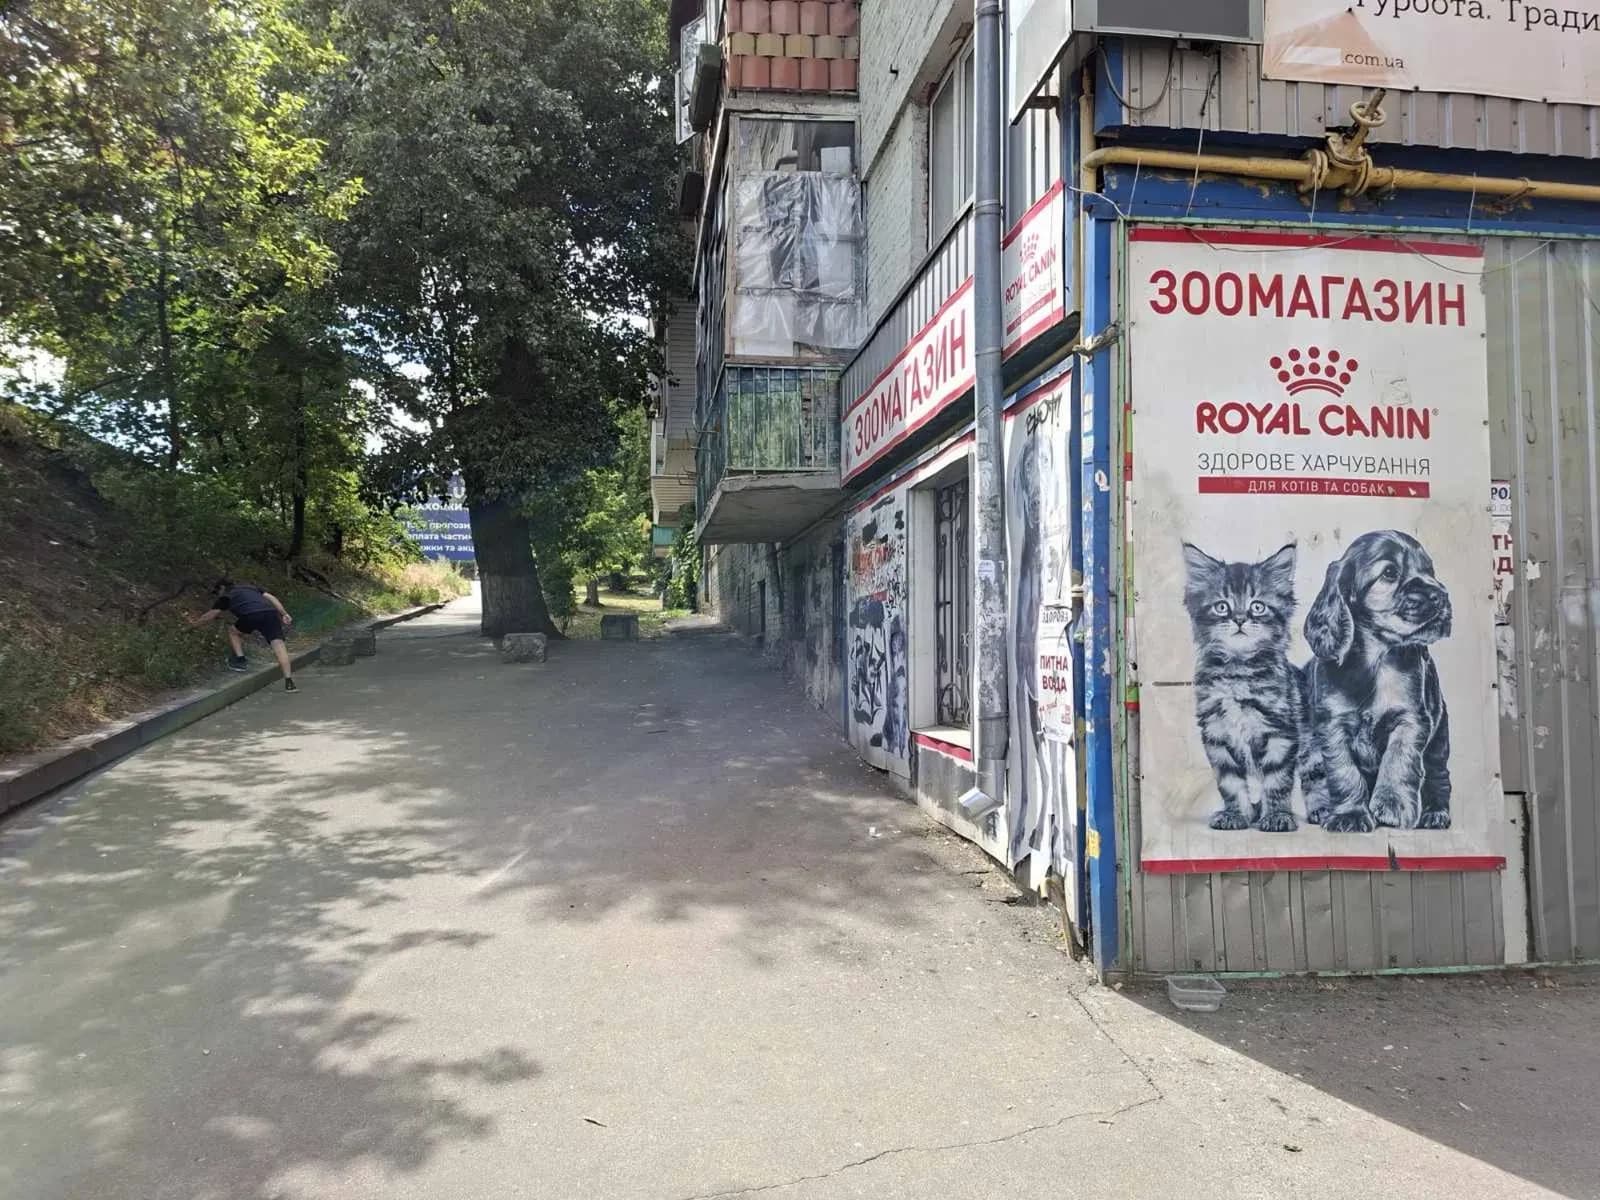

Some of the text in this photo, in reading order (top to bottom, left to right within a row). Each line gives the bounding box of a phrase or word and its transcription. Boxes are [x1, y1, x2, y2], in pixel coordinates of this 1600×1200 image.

[1341, 51, 1404, 69] .com.ua
[1005, 268, 1028, 305] ROYAL
[1029, 245, 1057, 283] CANIN
[1149, 269, 1466, 327] ЗООМАГАЗИН
[854, 309, 966, 457] ЗООМАГАЗИН
[1196, 401, 1311, 435] ROYAL
[1197, 452, 1431, 476] ЗДОРОВЕ ХАРЧУВАННЯ
[1247, 479, 1385, 497] ДЛЯ КОТІВ ТА СОБАК
[1491, 486, 1511, 499] РО
[1492, 556, 1513, 575] Д
[1040, 655, 1069, 672] ПИТНА
[1042, 675, 1068, 695] ВОДА
